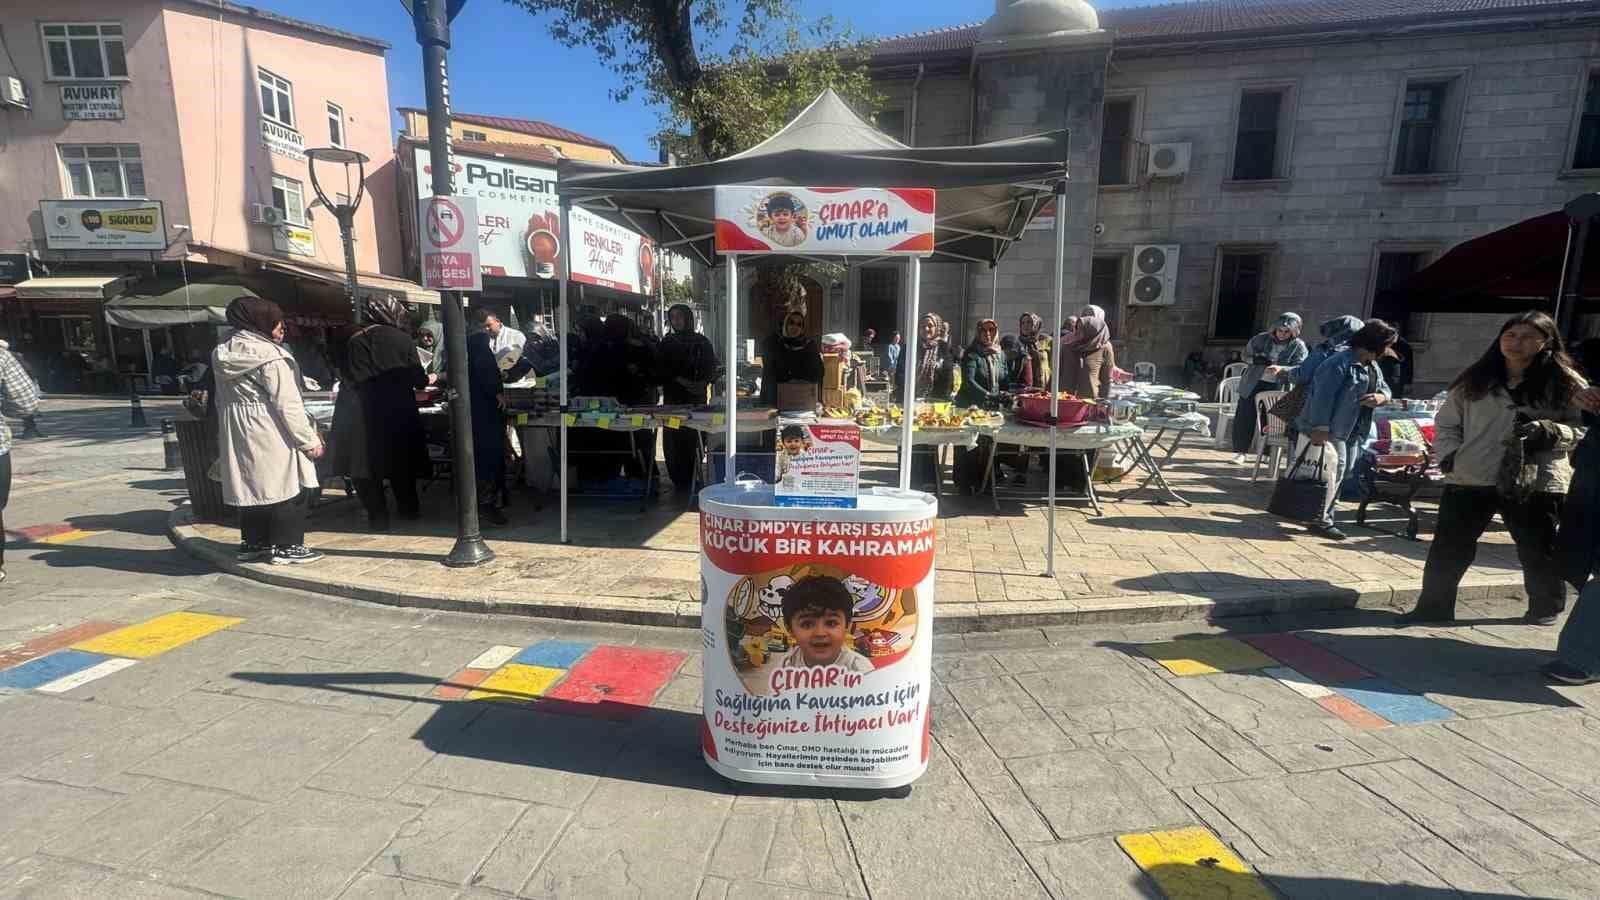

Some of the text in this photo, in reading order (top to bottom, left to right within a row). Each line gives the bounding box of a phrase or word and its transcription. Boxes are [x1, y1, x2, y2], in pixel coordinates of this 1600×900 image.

[64, 87, 117, 100] AVUKAT
[263, 122, 304, 145] AVUKAT
[466, 163, 559, 195] Polisan
[817, 219, 909, 241] UMUT OLALIM
[431, 255, 458, 265] YAYA
[748, 520, 812, 535] DMD'YE
[816, 522, 867, 539] KARŞI
[704, 530, 769, 553] KÜÇÜK
[817, 535, 933, 556] KAHRAMAN
[715, 688, 791, 717] Sağlığına
[894, 681, 920, 708] için
[715, 701, 919, 740] Desteğinize İhtiyacı Var!
